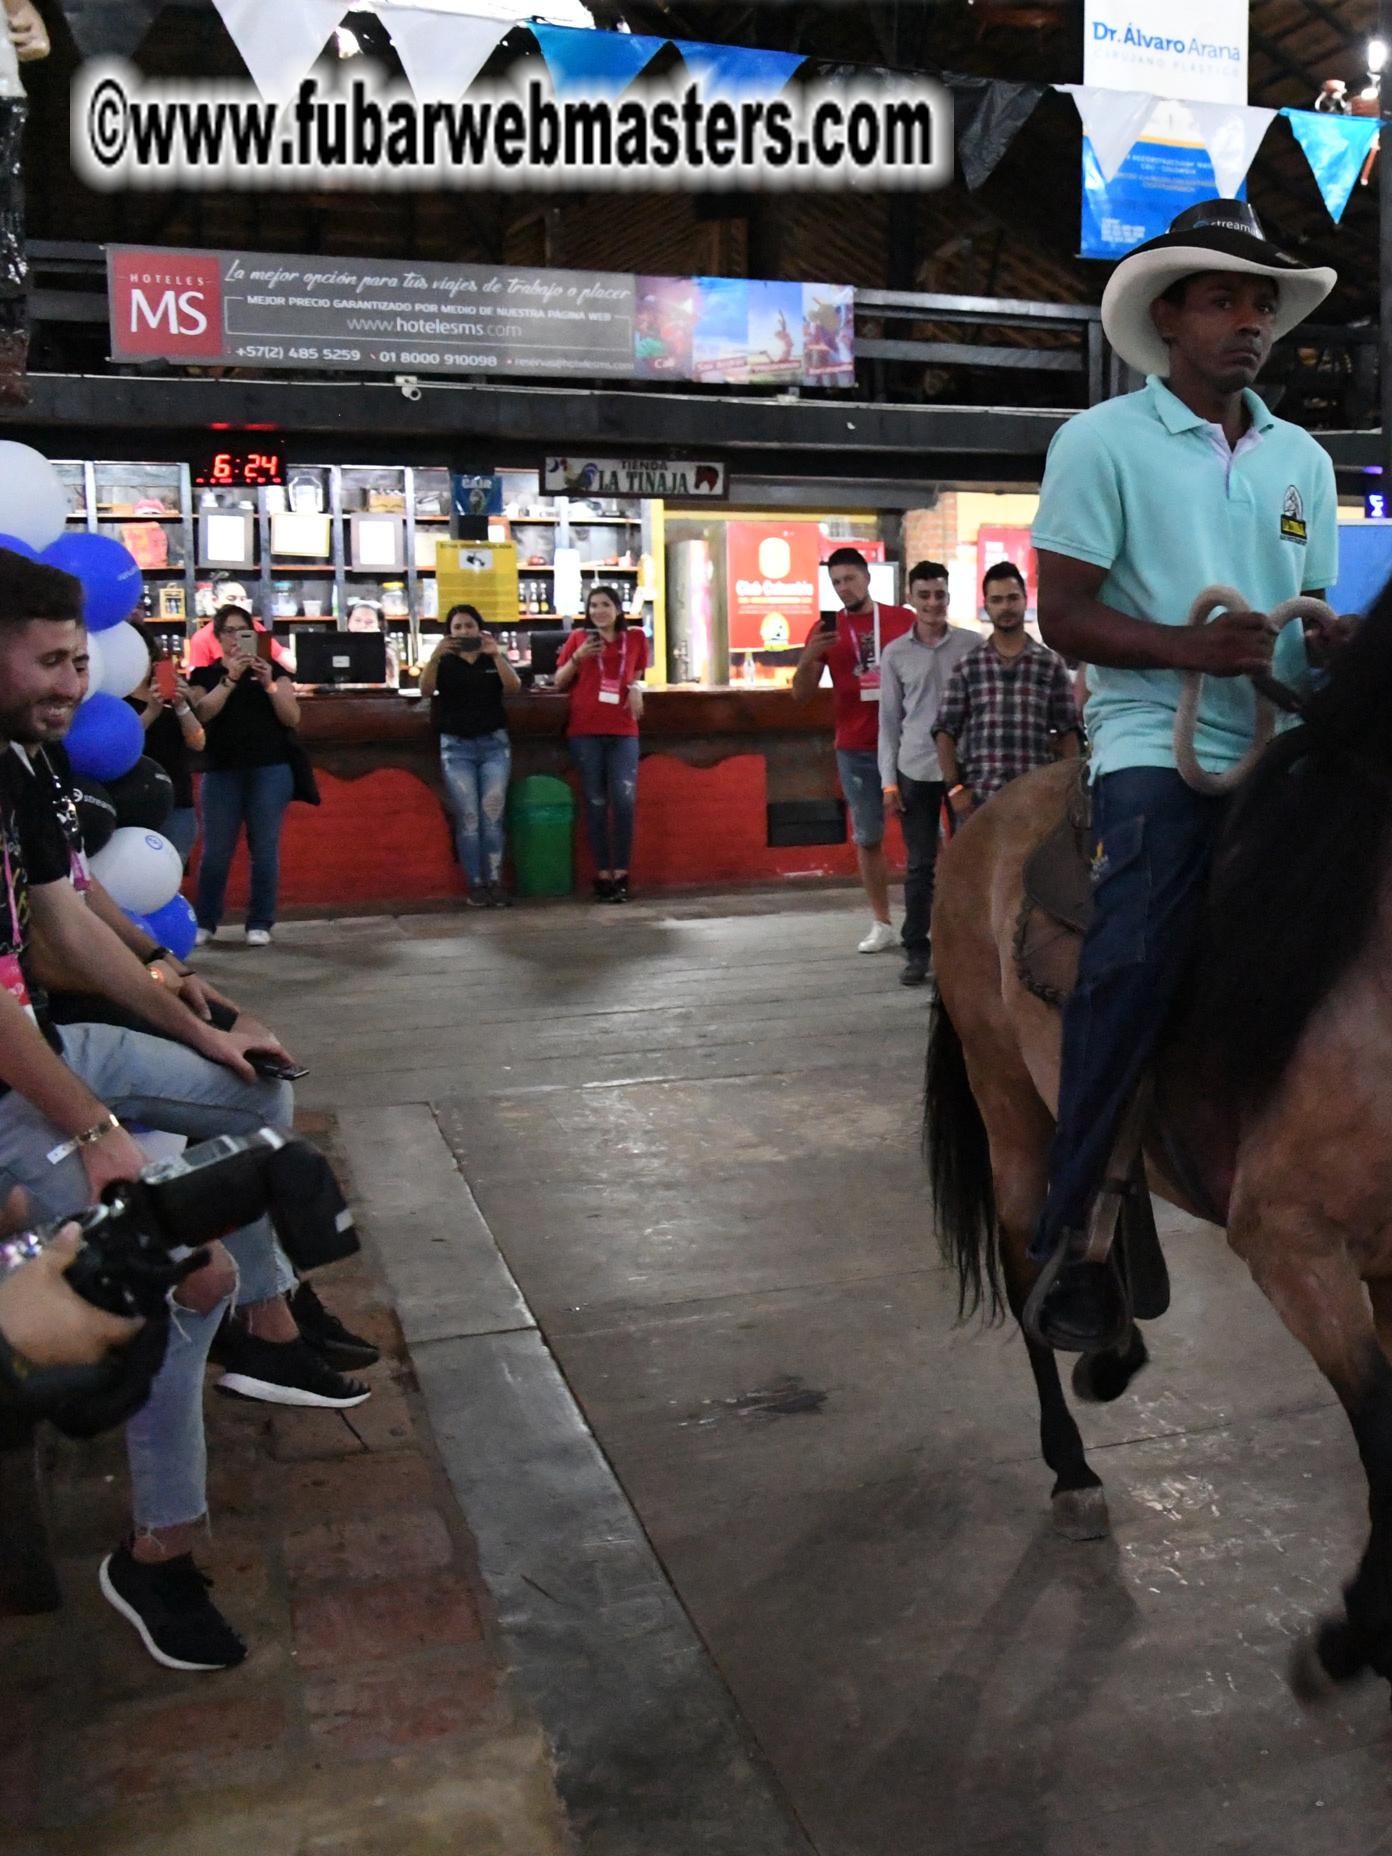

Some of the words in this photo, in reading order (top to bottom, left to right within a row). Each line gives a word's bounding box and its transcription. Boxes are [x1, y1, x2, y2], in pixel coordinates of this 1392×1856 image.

[1093, 22, 1121, 43] Dr.
[1123, 23, 1186, 54] Álvaro
[1188, 38, 1241, 61] Arana
[129, 273, 204, 286] HOTELES
[224, 259, 246, 282] La
[250, 267, 299, 289] mejor
[303, 270, 357, 291] opción
[356, 275, 398, 294] para
[402, 271, 428, 290] tus
[432, 275, 477, 298] viajes
[482, 276, 502, 293] de
[507, 276, 562, 304] trabajo
[566, 287, 577, 298] o
[576, 282, 632, 306] placer
[130, 288, 208, 336] MS
[247, 294, 286, 306] MEJOR
[288, 296, 331, 308] PRECIO
[333, 298, 412, 313] GARANTIZADO
[414, 302, 438, 314] POR
[440, 303, 477, 316] MEDIO
[479, 305, 494, 317] DE
[496, 306, 546, 320] NUESTRA
[588, 311, 613, 323] WEB
[347, 315, 523, 337] www.hotelesms.com
[235, 346, 284, 361] +57(2)
[288, 347, 319, 360] 485
[322, 348, 361, 362] 5259
[379, 351, 397, 364] 01
[400, 351, 440, 365] 8000
[444, 353, 498, 367] 910098
[213, 453, 278, 478] 6:24
[599, 470, 620, 493] LA
[626, 471, 690, 495] TINAJA
